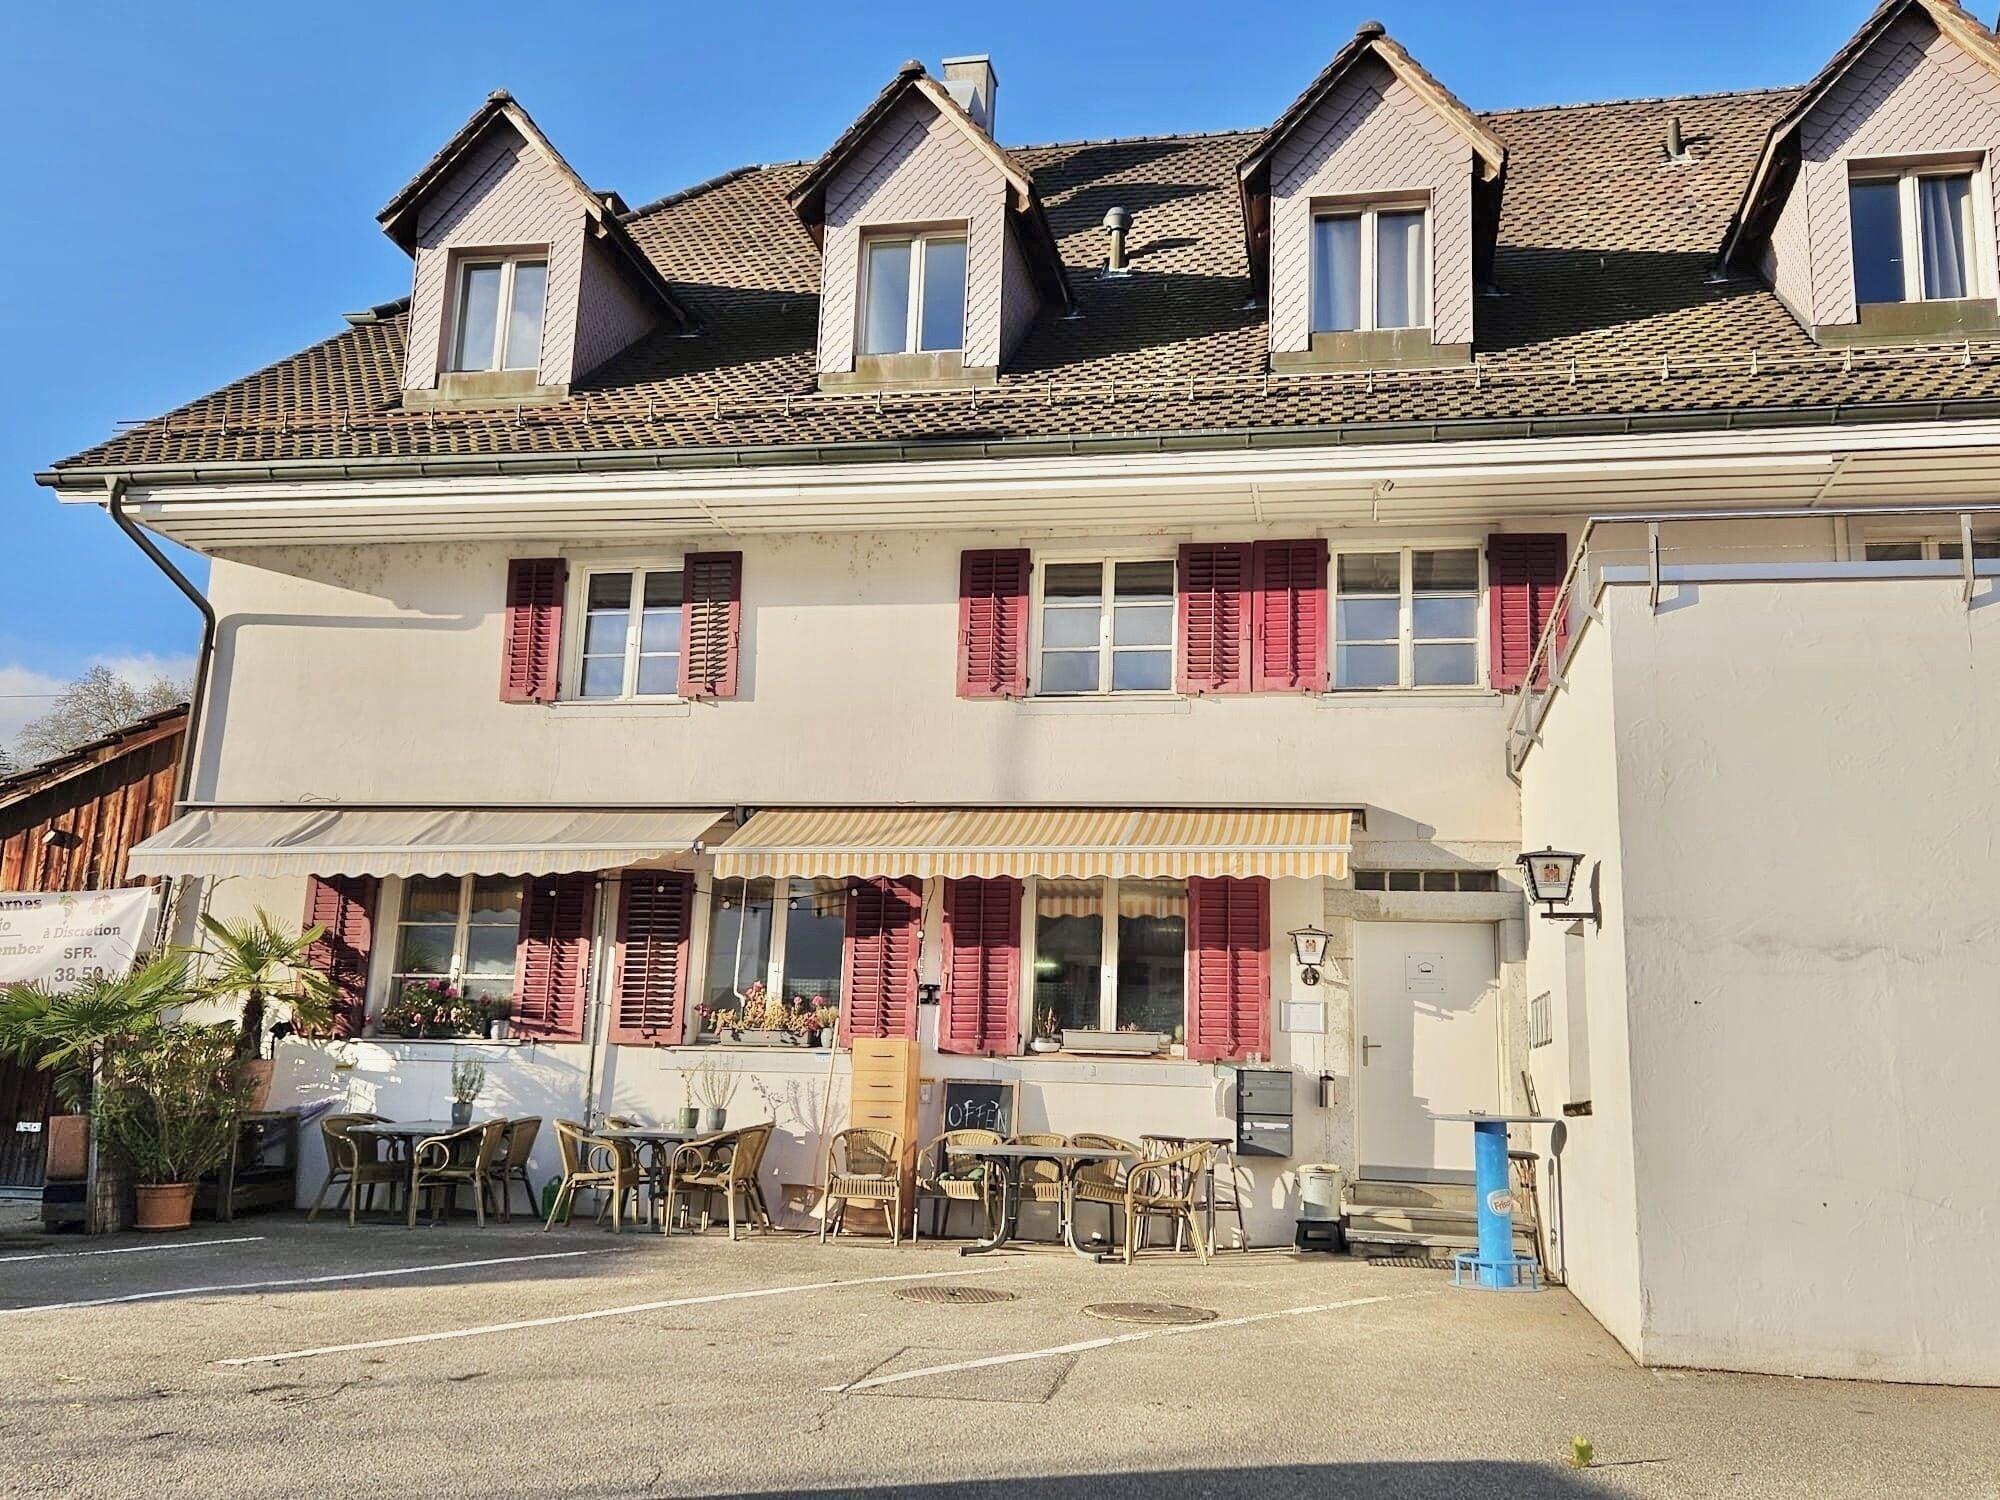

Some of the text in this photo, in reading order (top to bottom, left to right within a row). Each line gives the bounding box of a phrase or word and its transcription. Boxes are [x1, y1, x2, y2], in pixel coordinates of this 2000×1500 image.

[0, 943, 44, 956] mber
[63, 946, 98, 960] SFR.
[948, 1099, 1008, 1138] OFFEN
